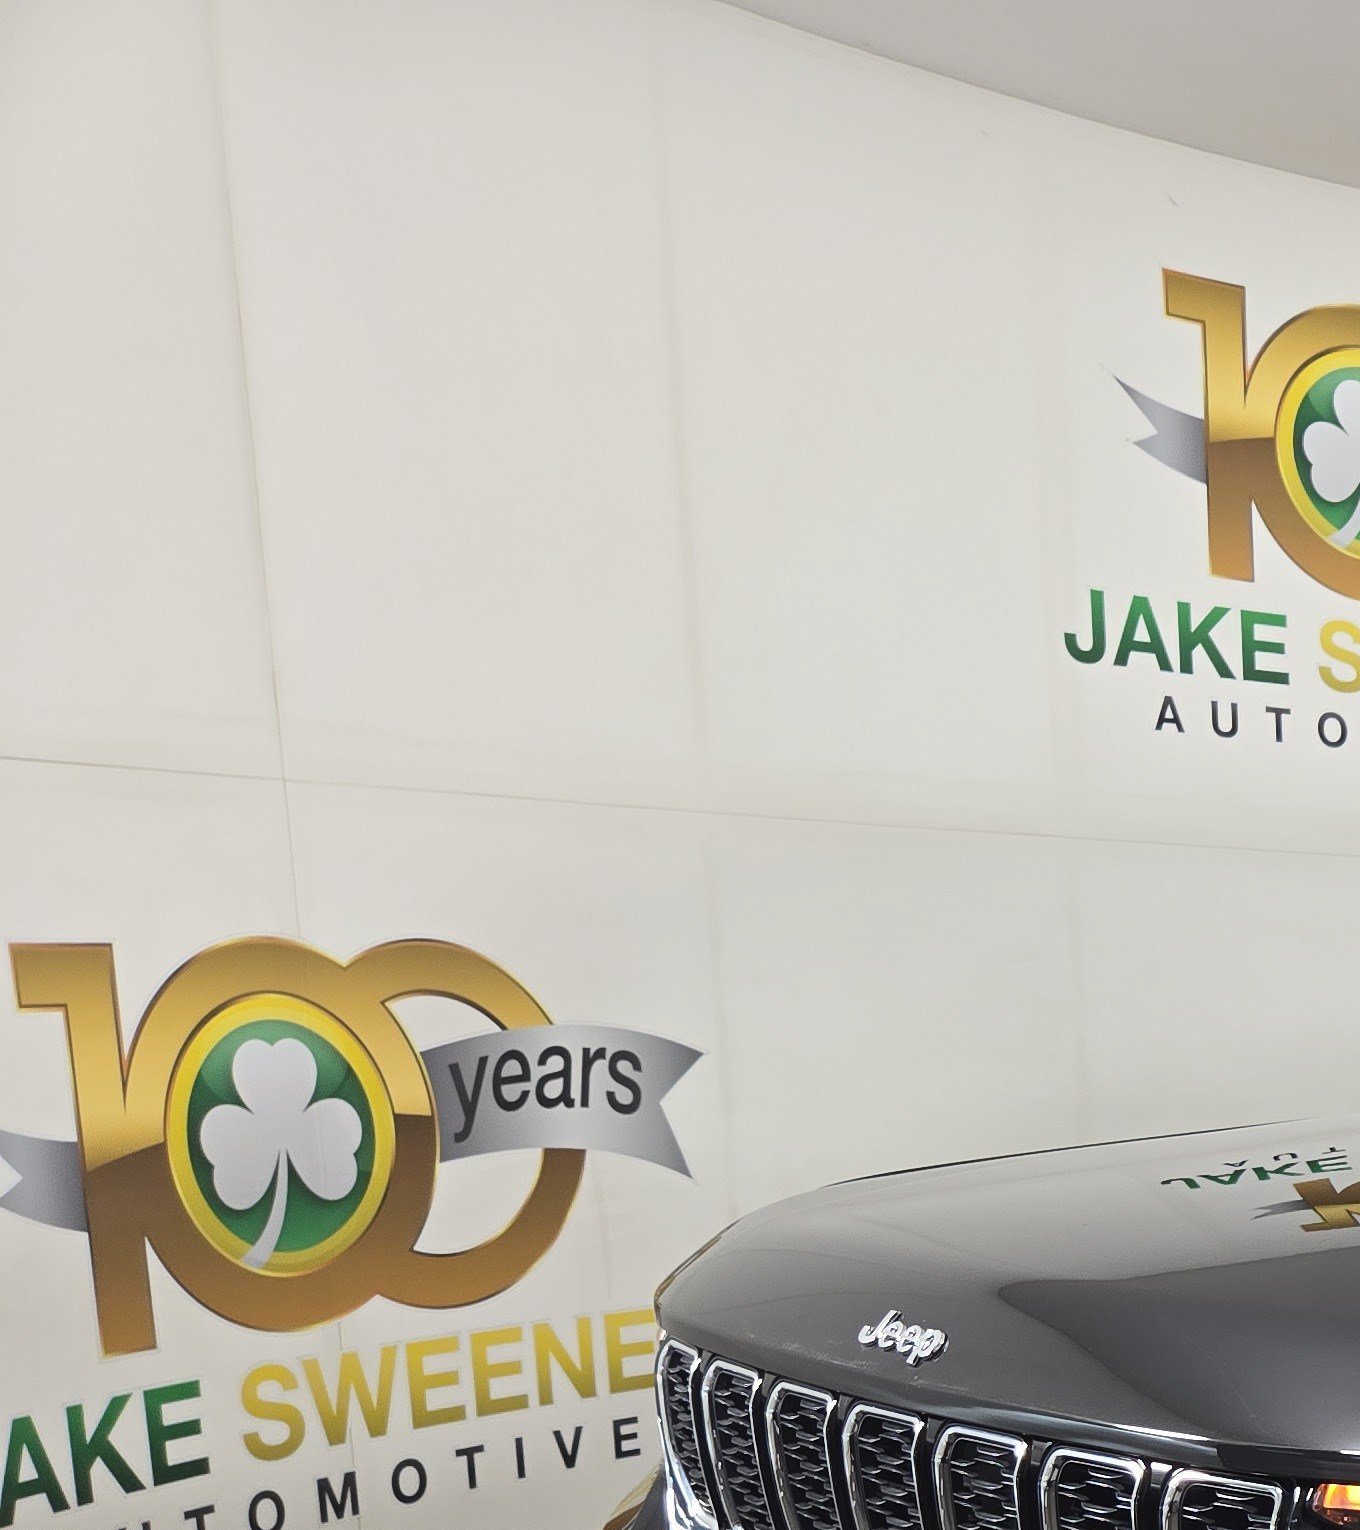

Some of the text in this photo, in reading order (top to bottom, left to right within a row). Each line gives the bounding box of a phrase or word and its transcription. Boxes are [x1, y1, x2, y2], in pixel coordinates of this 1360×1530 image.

[1064, 588, 1290, 685] JAKE
[449, 1044, 643, 1143] years
[858, 1310, 947, 1367] Jeep
[0, 1308, 656, 1529] AKE SWEENE
